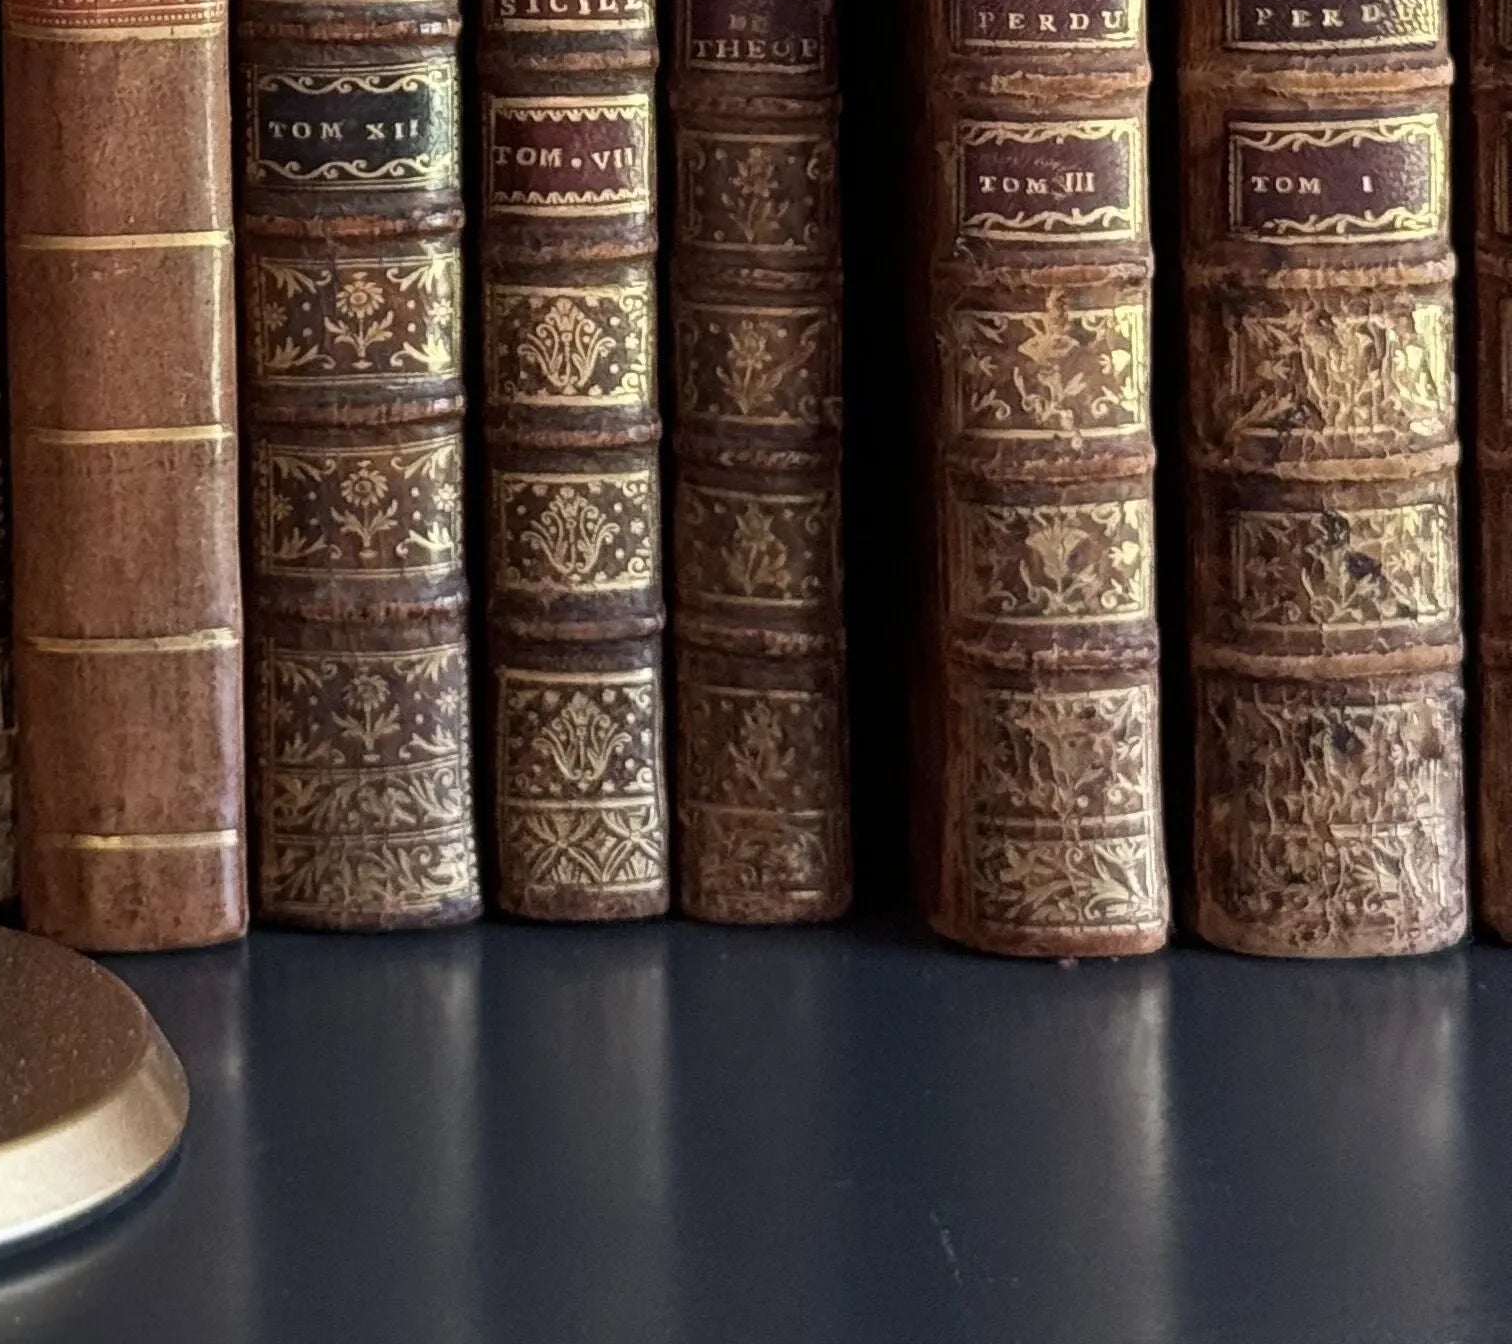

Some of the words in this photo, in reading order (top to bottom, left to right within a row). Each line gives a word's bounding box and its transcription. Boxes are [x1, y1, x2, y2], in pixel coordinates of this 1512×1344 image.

[977, 9, 1124, 33] PERDU
[268, 120, 345, 142] TOM
[365, 118, 420, 141] XII
[591, 146, 636, 173] VII
[978, 174, 1049, 196] TOM
[1063, 171, 1097, 194] III
[1250, 175, 1323, 195] TOM
